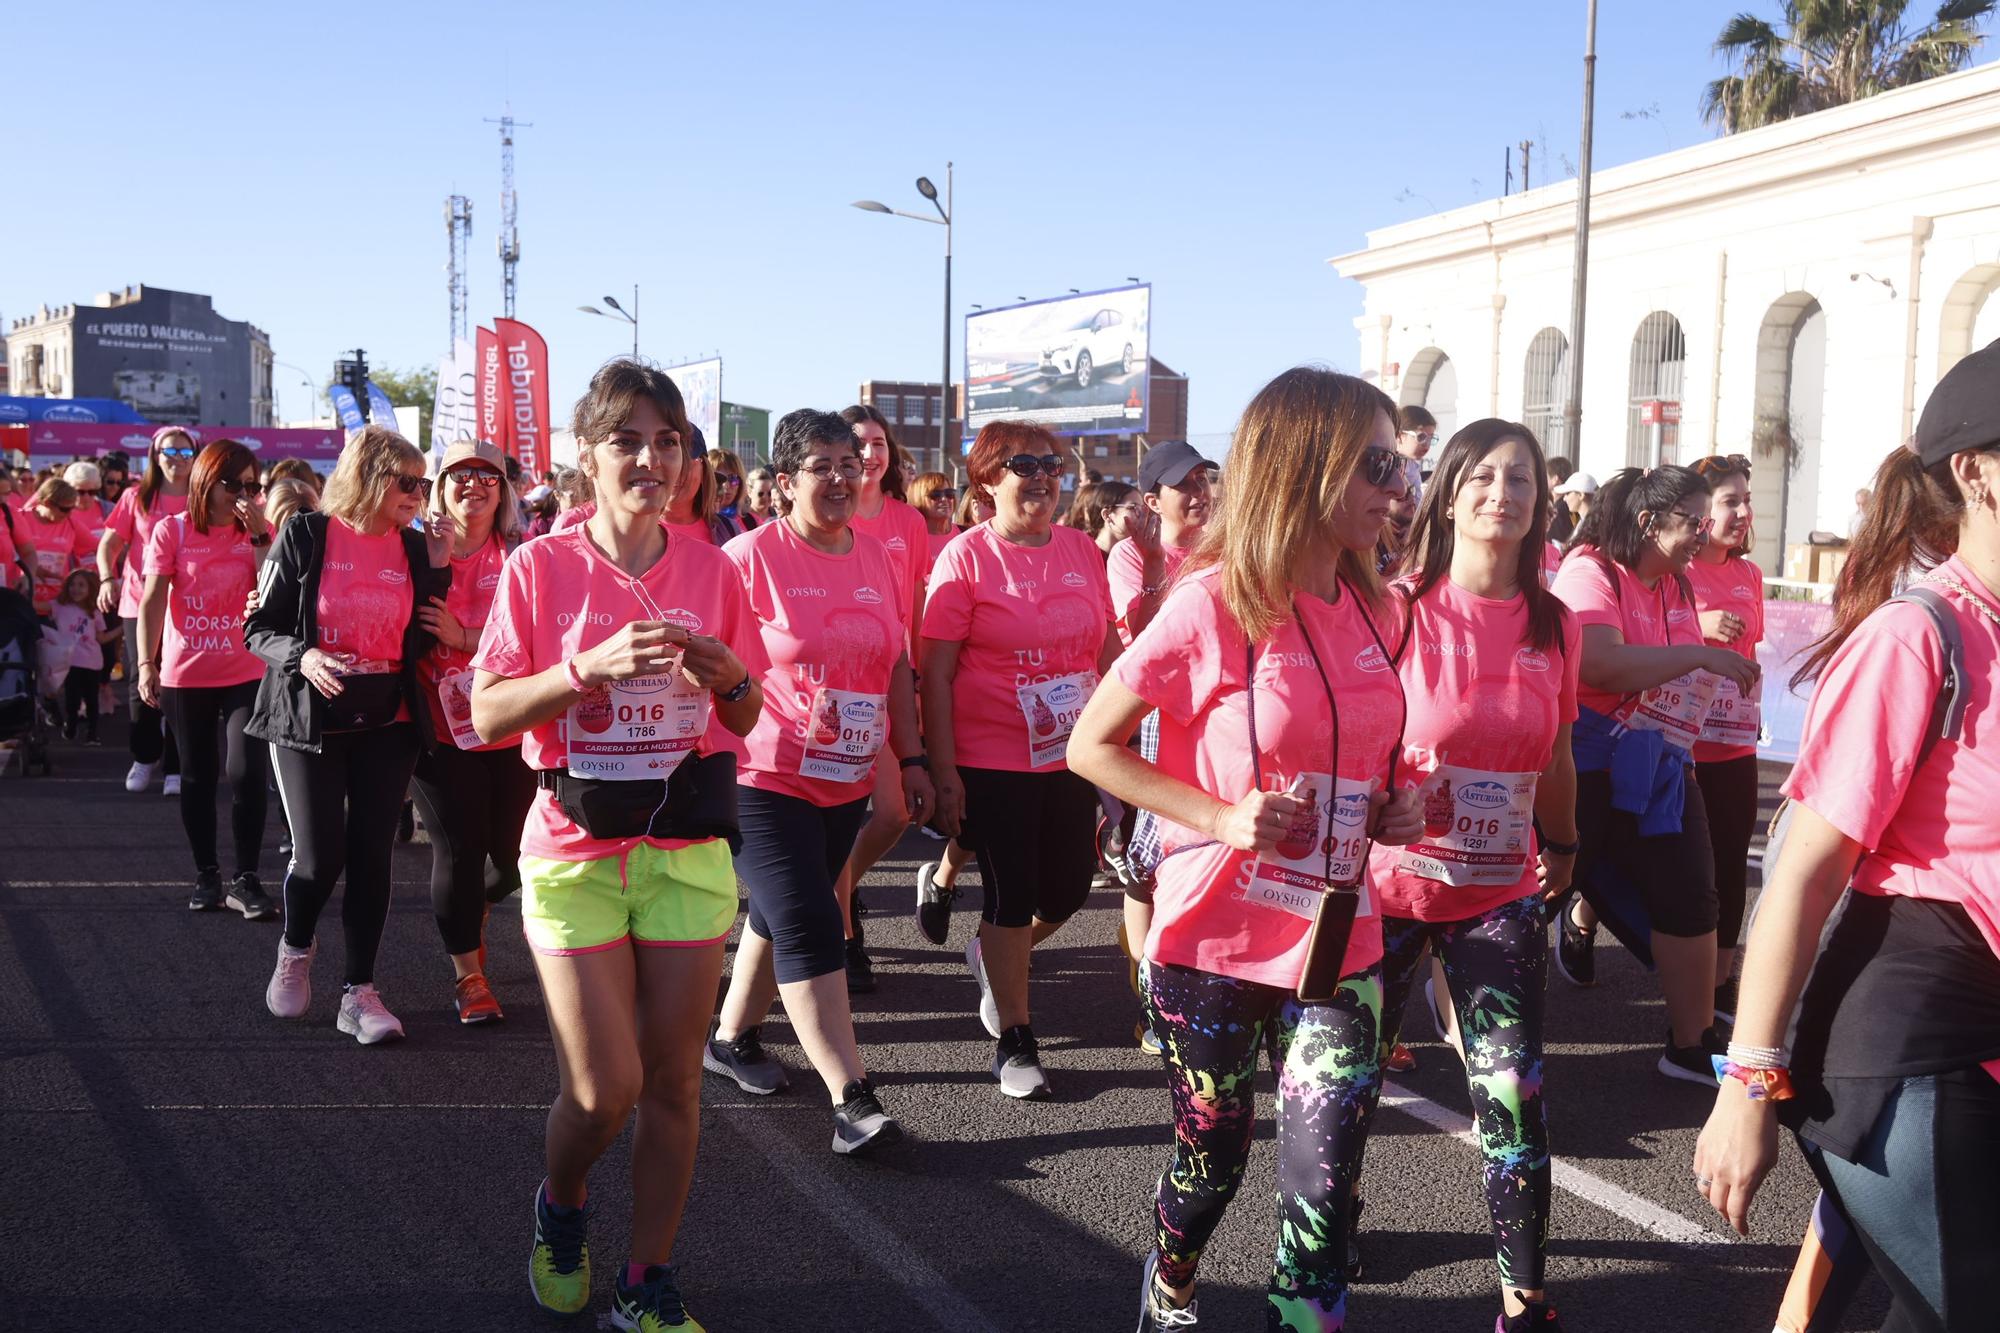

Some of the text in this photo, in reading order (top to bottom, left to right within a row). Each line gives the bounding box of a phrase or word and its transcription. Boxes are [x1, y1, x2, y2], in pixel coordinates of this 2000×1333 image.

[86, 324, 99, 335] EL
[102, 323, 148, 338] PUERTO
[324, 561, 354, 571] YSHO
[786, 587, 826, 598] OYSHO
[184, 596, 204, 610] TU
[185, 615, 242, 631] DORSA
[183, 635, 232, 650] SUMA
[1420, 642, 1474, 658] OYSHO
[1014, 648, 1043, 666] TU
[1264, 653, 1316, 669] OYSHO
[794, 663, 825, 685] TU
[615, 677, 669, 688] ASTURIANA
[618, 703, 665, 722] 016
[1057, 708, 1081, 724] 016
[627, 725, 656, 738] 1786
[842, 728, 870, 743] 016
[585, 744, 624, 753] CARRERA
[626, 744, 638, 752] DE
[639, 743, 649, 751] LA
[651, 742, 677, 750] MUJER
[845, 743, 864, 753] 6211
[581, 760, 625, 772] OYSHO
[809, 763, 840, 775] OYSHO
[1461, 788, 1508, 803] ASTURIANA
[1457, 816, 1500, 835] 016
[1321, 836, 1360, 858] 016
[1462, 837, 1488, 849] 1291
[1420, 847, 1455, 859] CARRERA
[1457, 853, 1468, 862] DE
[1329, 861, 1351, 876] 289
[1411, 858, 1453, 876] OYSHO
[1273, 871, 1316, 887] CARRERA
[1263, 889, 1311, 908] OYSHO
